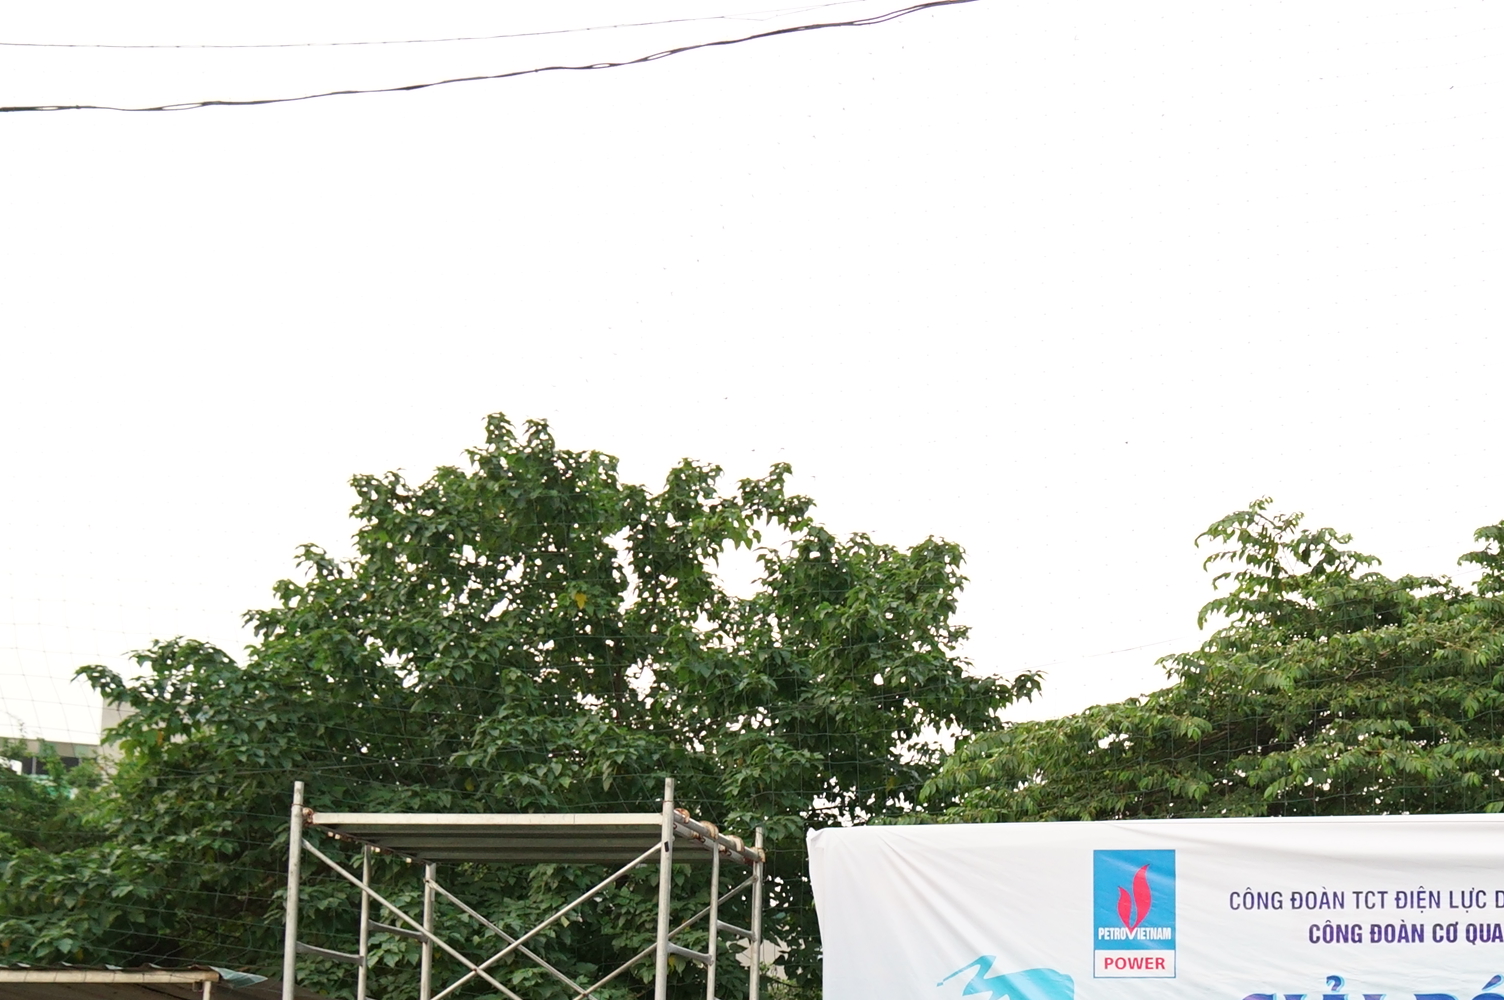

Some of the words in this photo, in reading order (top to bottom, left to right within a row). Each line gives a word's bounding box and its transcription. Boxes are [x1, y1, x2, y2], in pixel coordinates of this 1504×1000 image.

[1229, 886, 1283, 910] CÔNG
[1289, 886, 1345, 910] ĐOÀN
[1352, 890, 1388, 910] TCT
[1394, 885, 1441, 914] ĐIỆN
[1449, 886, 1487, 914] LỰC
[1098, 927, 1172, 940] PETROVIETNAM
[1308, 919, 1363, 944] CÔNG
[1369, 919, 1425, 944] ĐOÀN
[1431, 921, 1459, 944] CƠ
[1104, 957, 1166, 970] POWER
